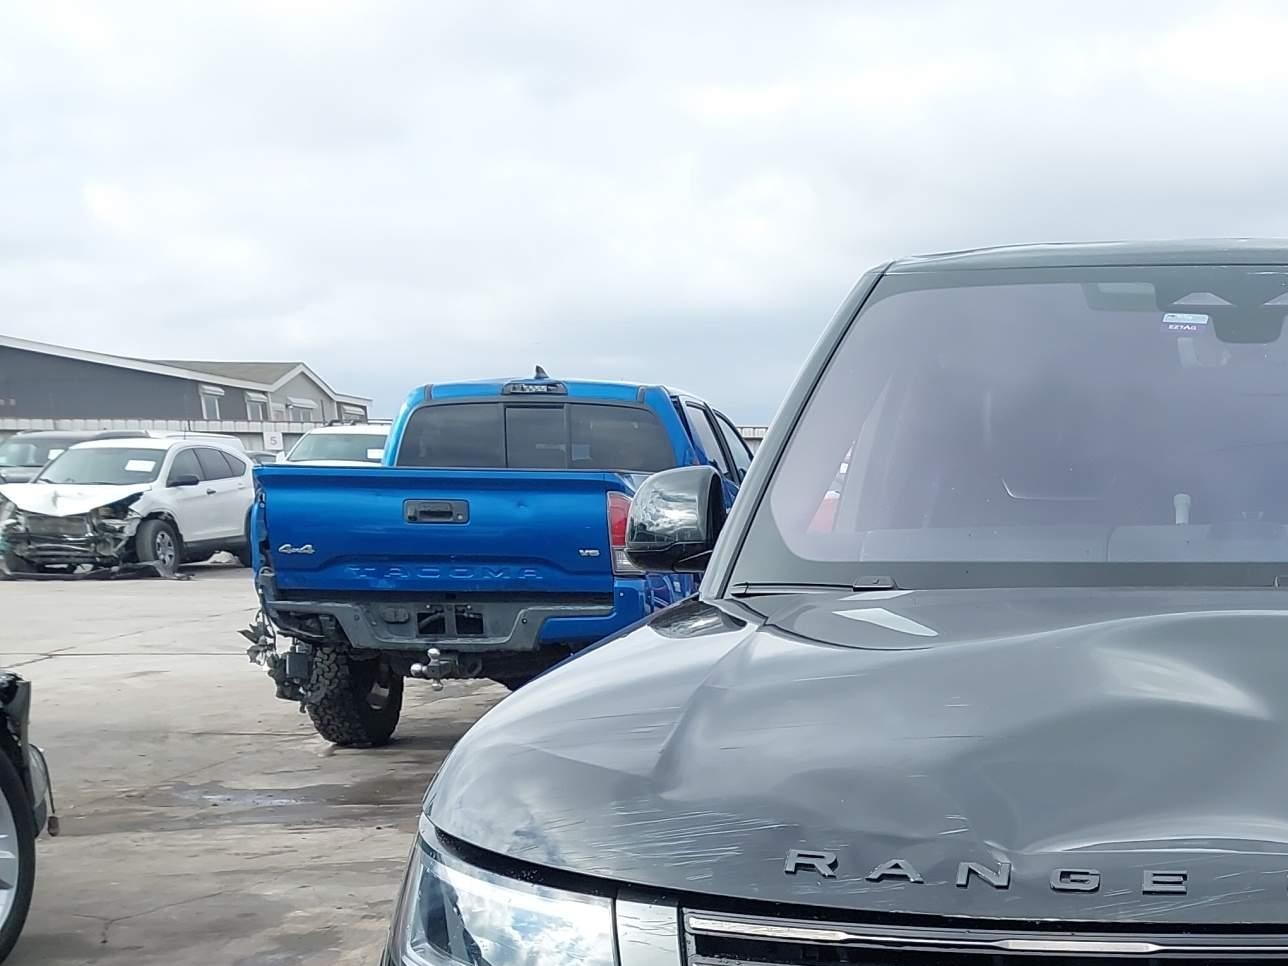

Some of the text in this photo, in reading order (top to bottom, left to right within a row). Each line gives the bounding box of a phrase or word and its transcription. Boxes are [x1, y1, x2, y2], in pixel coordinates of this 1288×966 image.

[278, 543, 316, 554] 4x4
[347, 566, 545, 580] TACOMA
[783, 848, 1189, 896] RANGE
